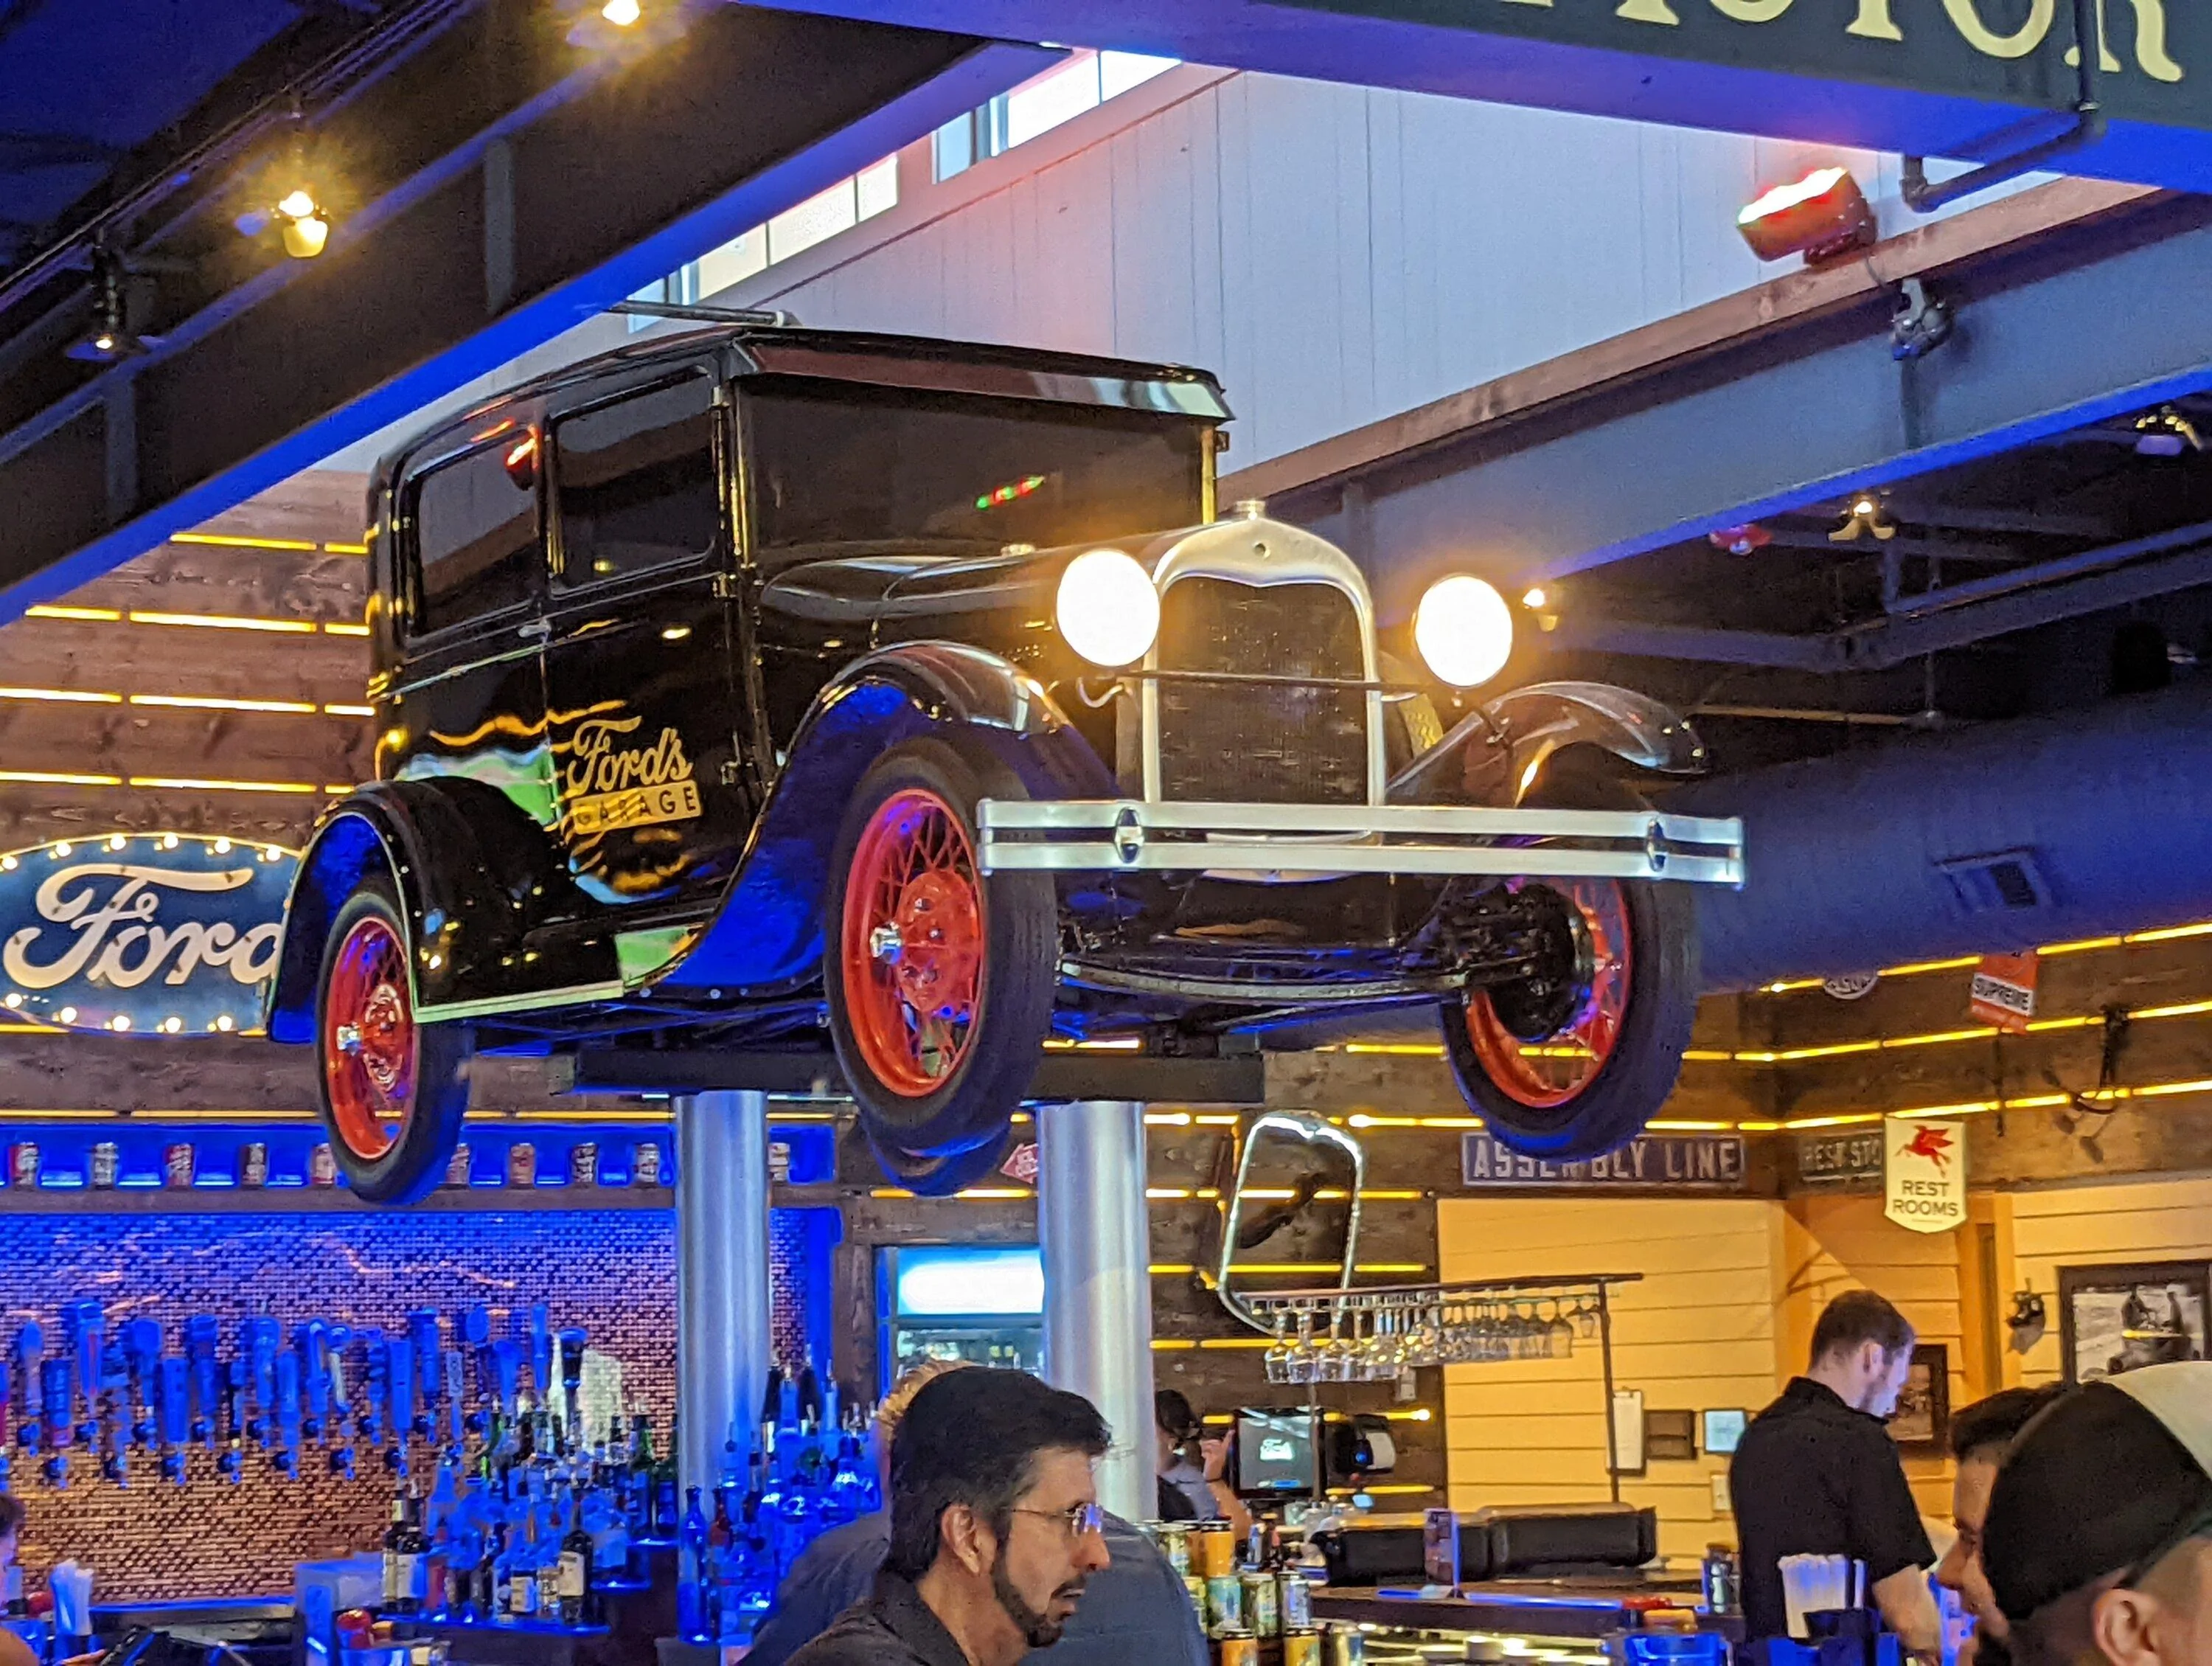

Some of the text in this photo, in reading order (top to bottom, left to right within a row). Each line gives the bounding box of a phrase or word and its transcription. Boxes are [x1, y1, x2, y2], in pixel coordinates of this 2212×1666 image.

[567, 716, 694, 793] Ford's
[1665, 1142, 1737, 1179] LINE
[1902, 1180, 1950, 1196] REST
[1893, 1200, 1958, 1216] ROOMS
